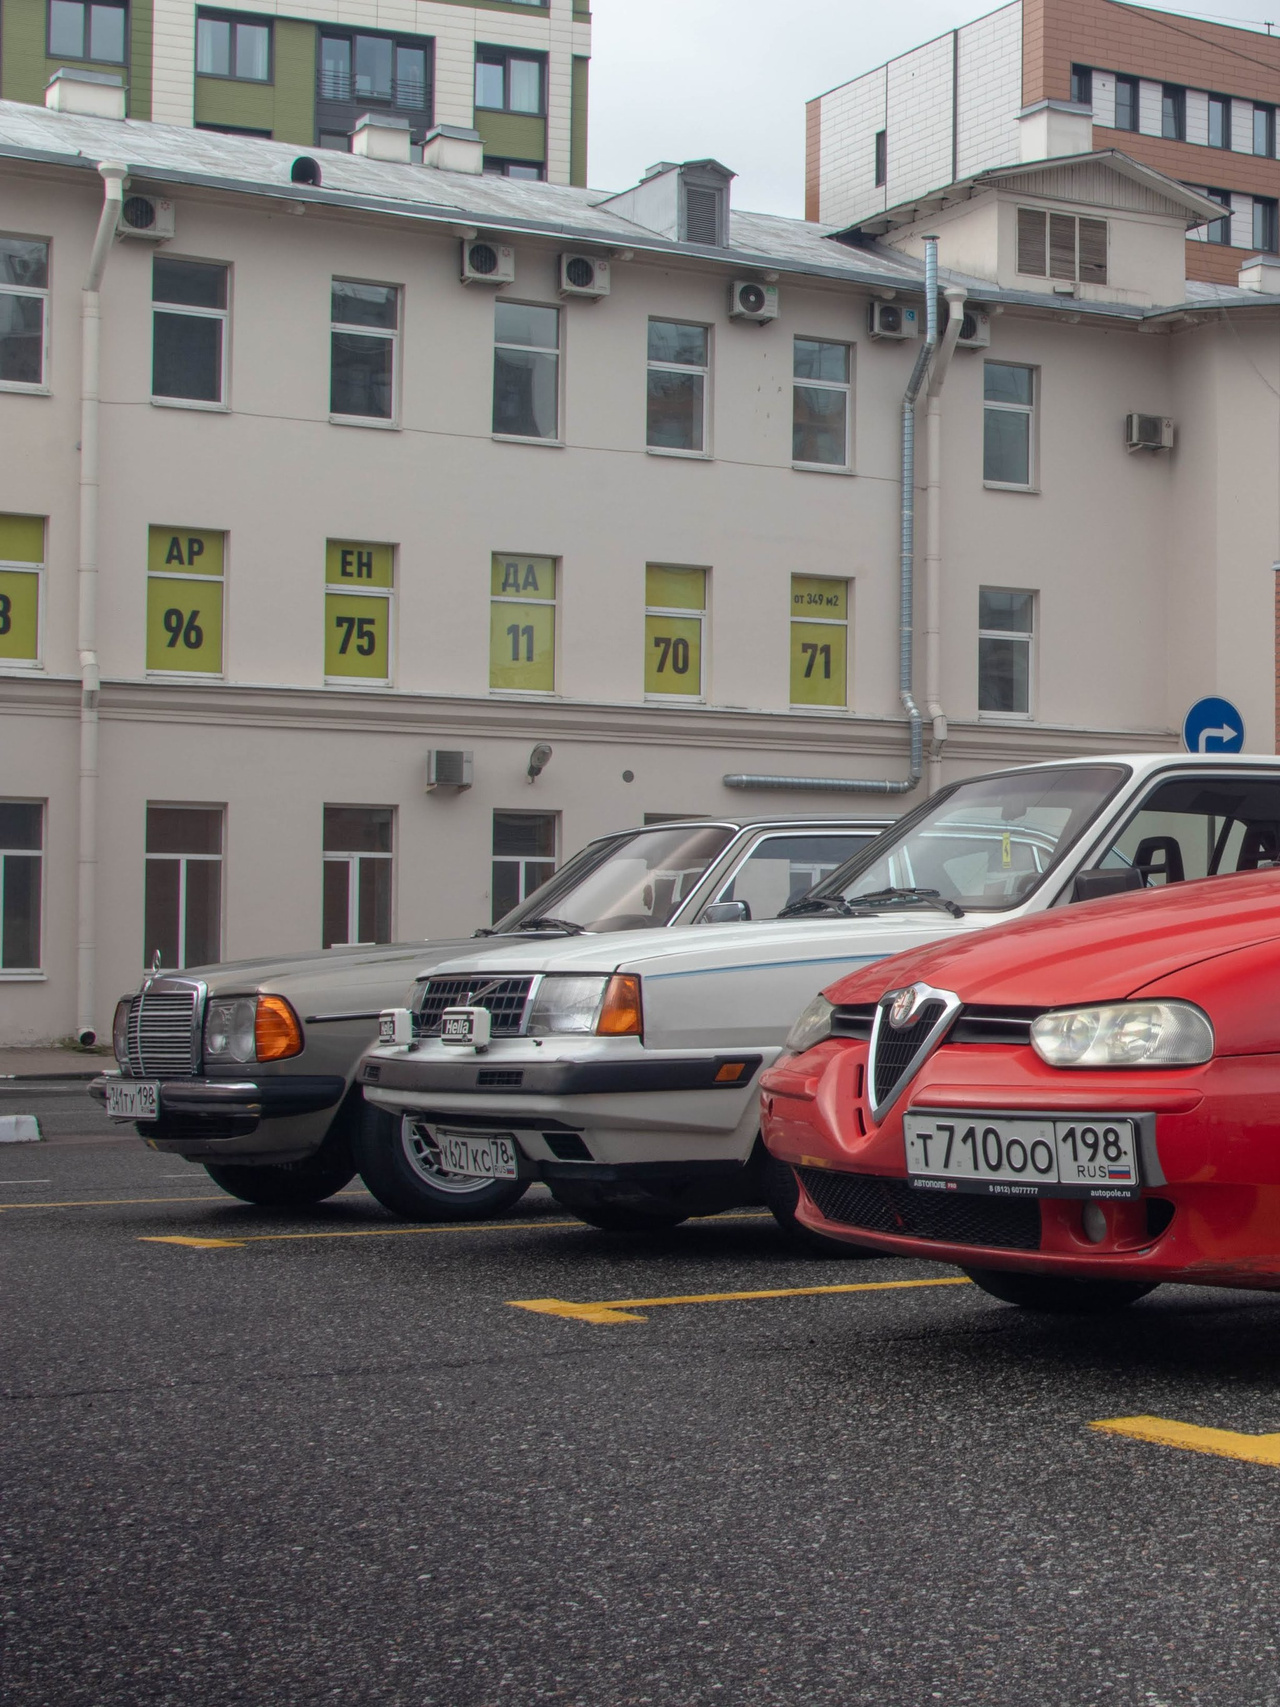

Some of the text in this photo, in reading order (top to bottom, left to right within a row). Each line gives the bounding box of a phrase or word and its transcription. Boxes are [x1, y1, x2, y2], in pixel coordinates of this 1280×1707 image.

[165, 537, 204, 566] АР
[341, 549, 373, 579] ЕН
[502, 562, 539, 593] ДА
[807, 592, 824, 606] 349
[164, 608, 204, 649] 96
[336, 616, 376, 656] 75
[507, 624, 534, 662] 11
[654, 637, 689, 675] 70
[801, 642, 831, 679] 71
[445, 1019, 469, 1034] Hella
[137, 1086, 155, 1105] 198
[491, 1141, 509, 1164] 78
[1061, 1126, 1122, 1162] 198
[1077, 1165, 1107, 1178] RUS
[995, 1185, 1010, 1194] (812)
[1090, 1189, 1131, 1198] autopole.ru
